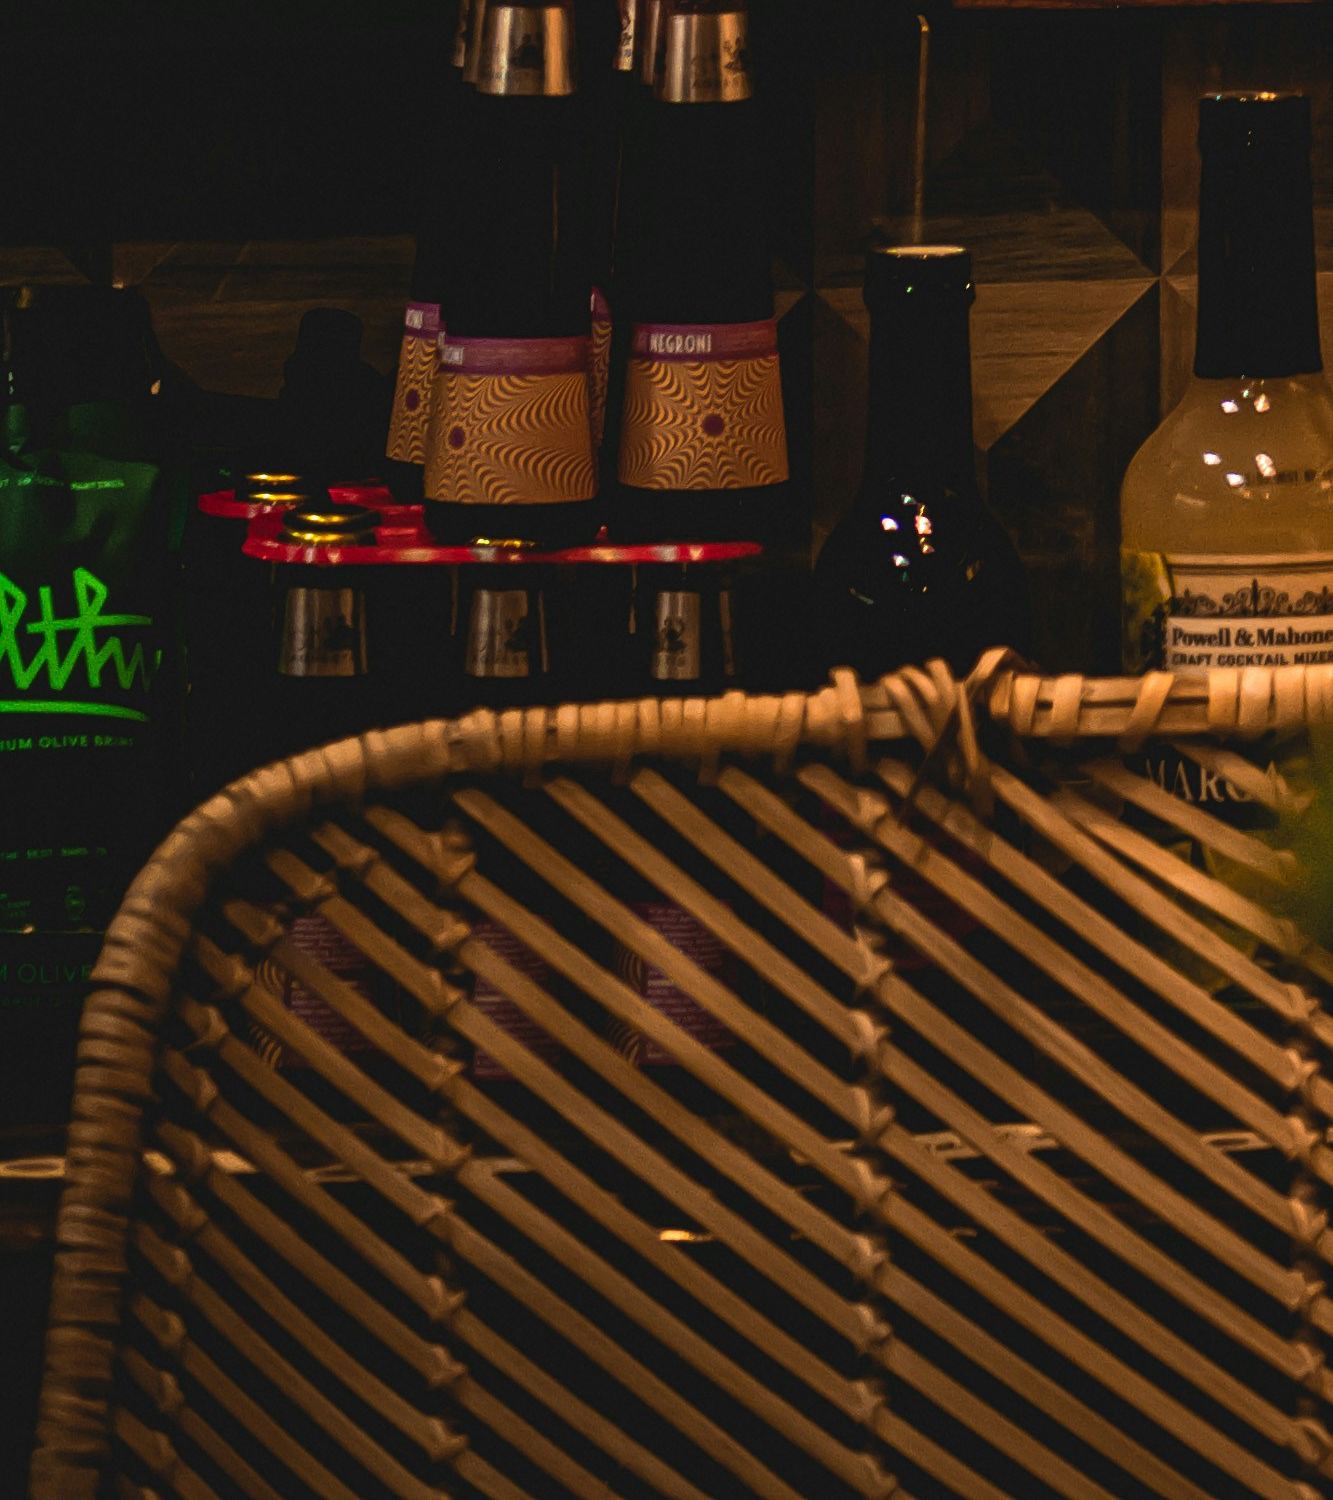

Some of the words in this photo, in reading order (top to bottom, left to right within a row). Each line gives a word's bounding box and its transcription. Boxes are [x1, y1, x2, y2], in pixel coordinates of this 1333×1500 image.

[650, 333, 712, 354] NEGRONI
[1171, 627, 1231, 647] Powell
[1234, 629, 1254, 647] &
[1171, 652, 1213, 666] CRAFT
[1217, 651, 1288, 666] COCKTAIL
[38, 734, 88, 749] OLIVE
